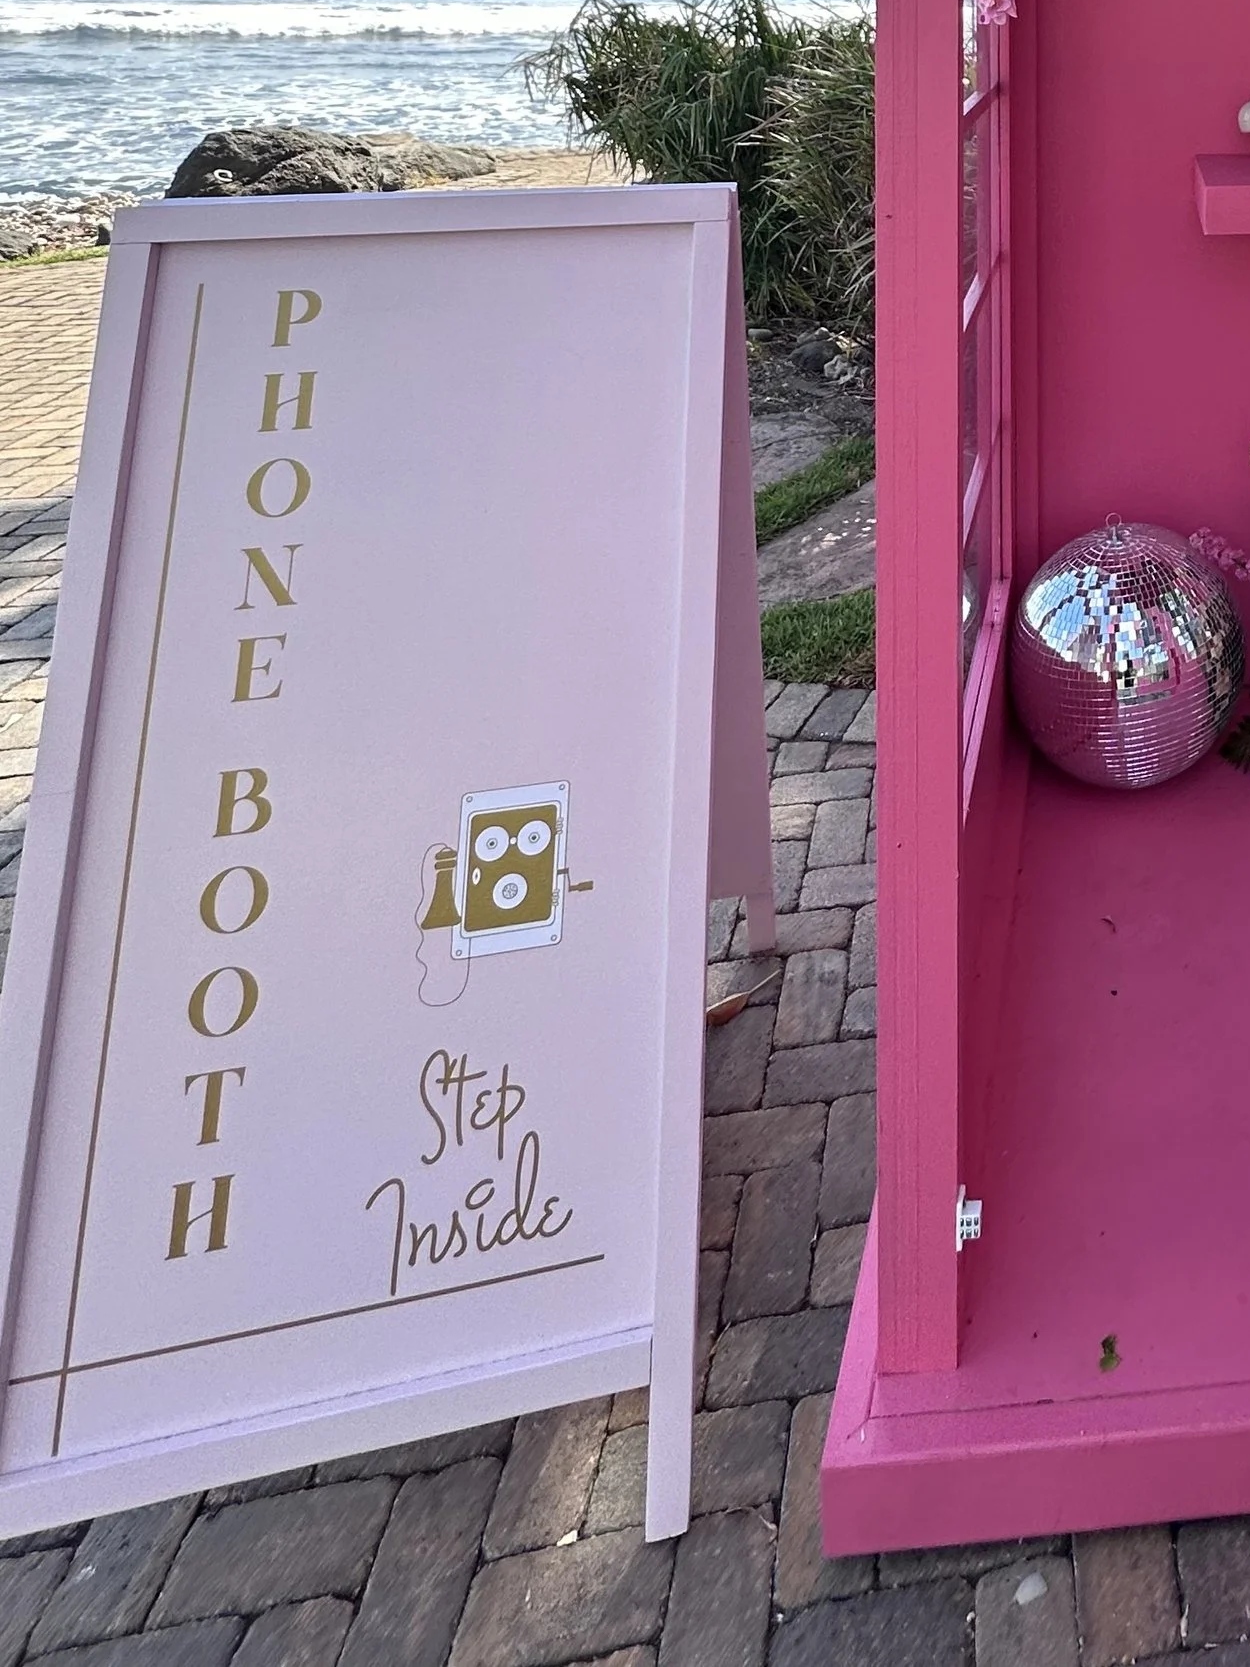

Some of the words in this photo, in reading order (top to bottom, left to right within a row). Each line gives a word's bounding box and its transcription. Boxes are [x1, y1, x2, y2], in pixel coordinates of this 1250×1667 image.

[230, 288, 324, 706] PHONE
[162, 768, 274, 1262] BOOTH
[419, 1048, 526, 1165] Step
[365, 1130, 573, 1296] Inside
